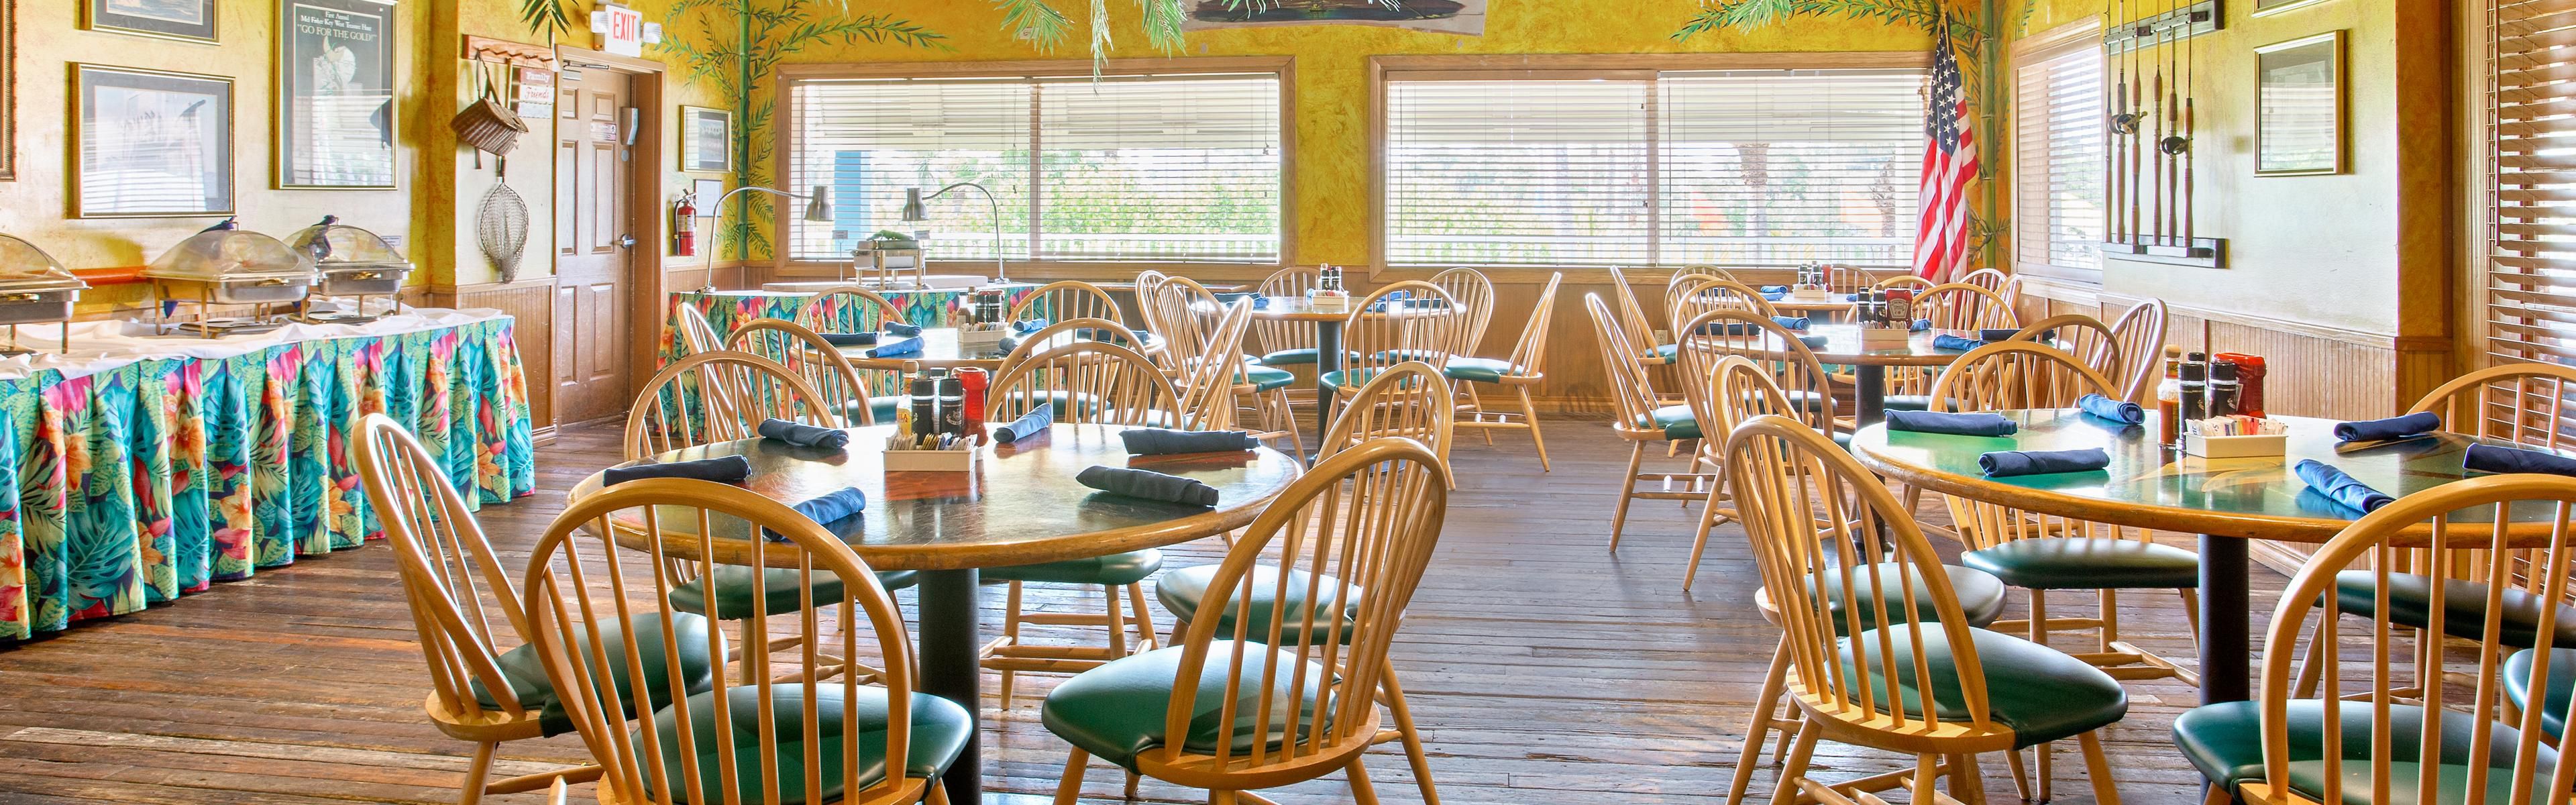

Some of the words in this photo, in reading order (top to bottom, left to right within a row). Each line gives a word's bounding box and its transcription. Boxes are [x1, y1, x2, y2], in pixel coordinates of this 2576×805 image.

[324, 18, 333, 28] Key
[613, 11, 637, 42] EXIT
[316, 26, 332, 36] FOR
[332, 29, 349, 39] THE
[525, 71, 551, 83] Family
